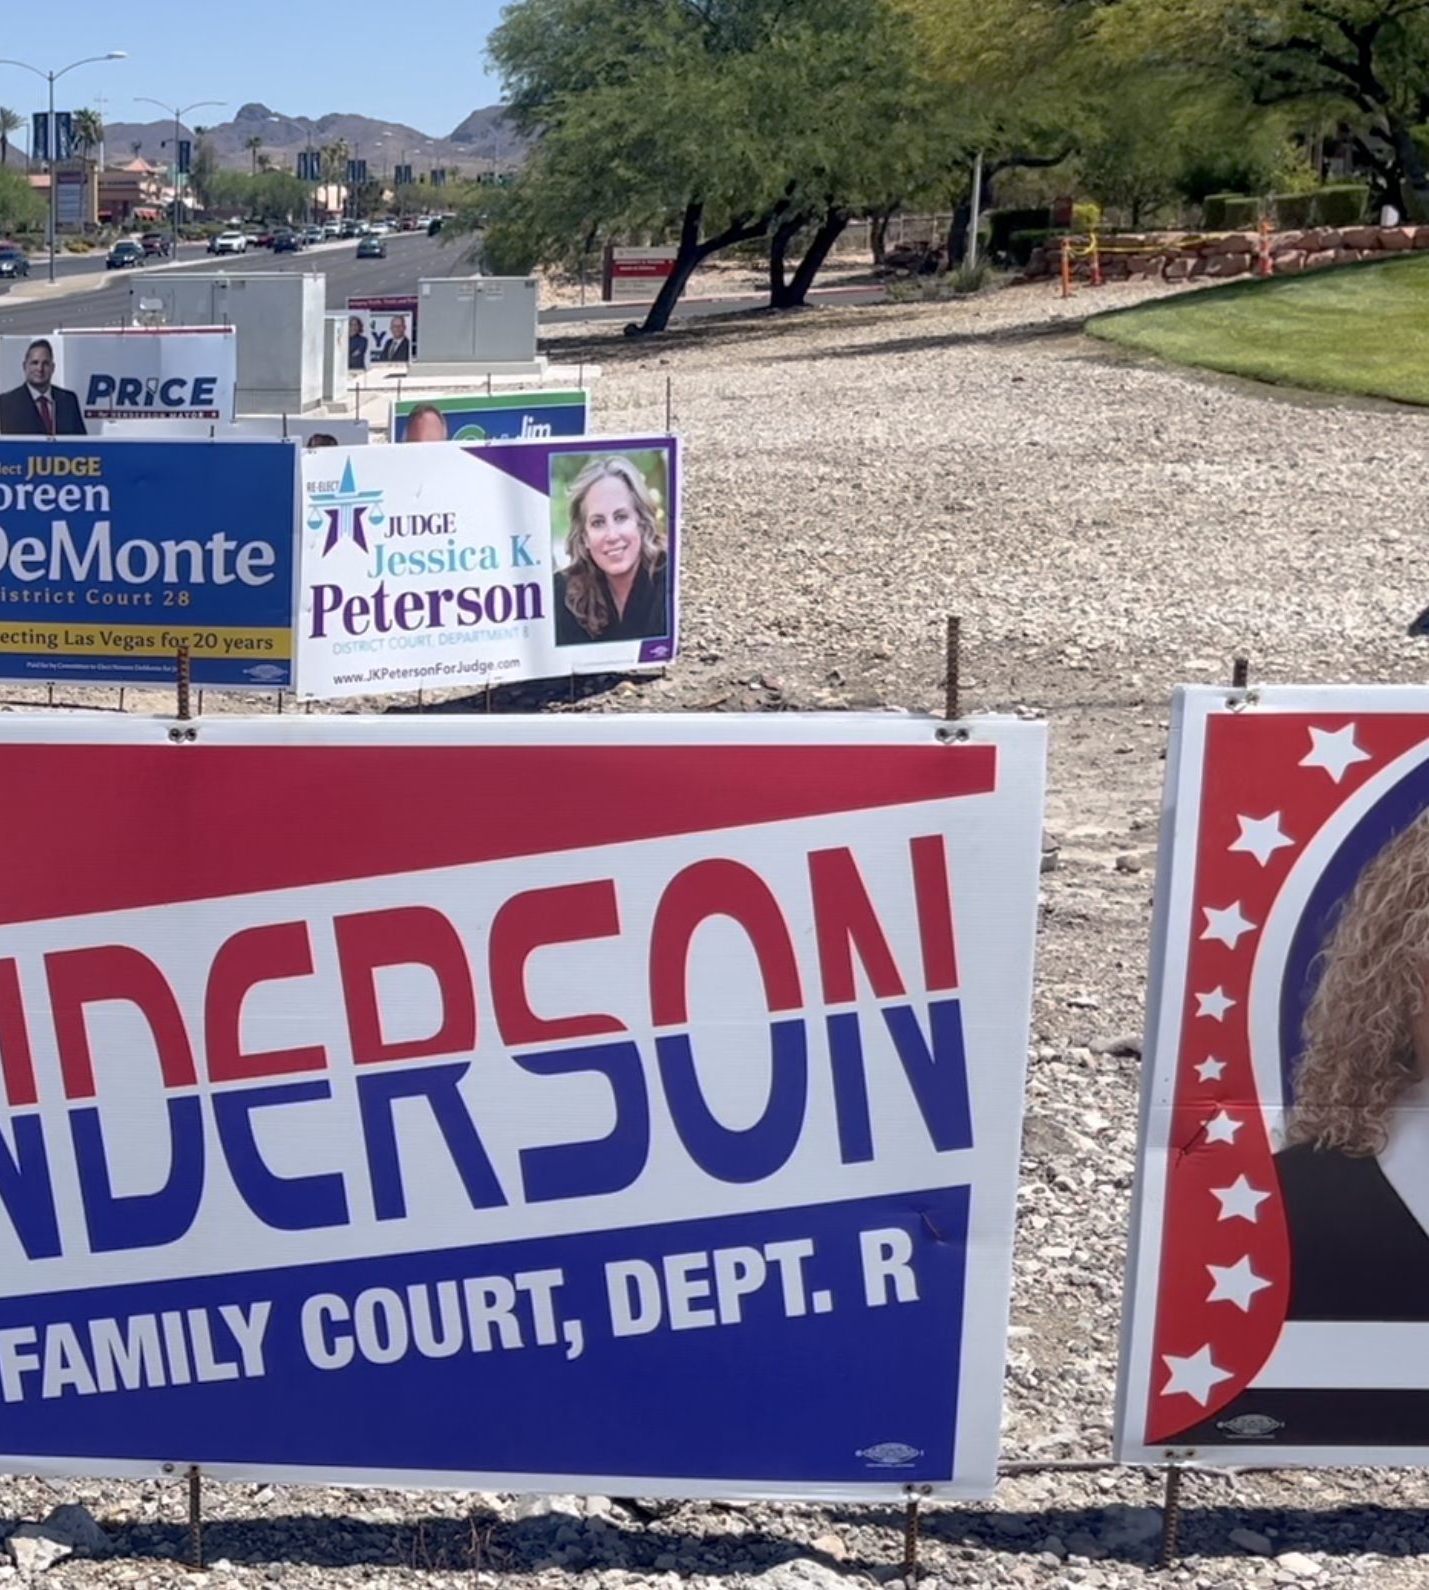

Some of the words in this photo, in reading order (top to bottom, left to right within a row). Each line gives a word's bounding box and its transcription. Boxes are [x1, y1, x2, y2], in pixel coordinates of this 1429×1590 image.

[86, 374, 218, 407] PRICE
[26, 456, 101, 480] JUDGE
[306, 481, 340, 493] RE-ELECT
[384, 512, 457, 538] JUDGE
[367, 538, 499, 579] Jessica
[510, 534, 542, 567] K.
[86, 588, 152, 606] Court
[163, 590, 190, 606] 28
[308, 580, 545, 639] Peterson
[64, 630, 95, 646] Las
[100, 631, 155, 651] Vegas
[160, 632, 189, 648] for
[193, 633, 219, 649] 20
[223, 636, 274, 653] years
[333, 638, 386, 655] DISTRICT
[388, 634, 434, 650] COURT,
[438, 628, 519, 646] DEPARTMENT
[333, 657, 521, 685] www.JKPetersonForJudge.com
[302, 1268, 584, 1371] COURT,
[604, 1237, 833, 1338] DEPT.
[859, 1227, 920, 1307] R
